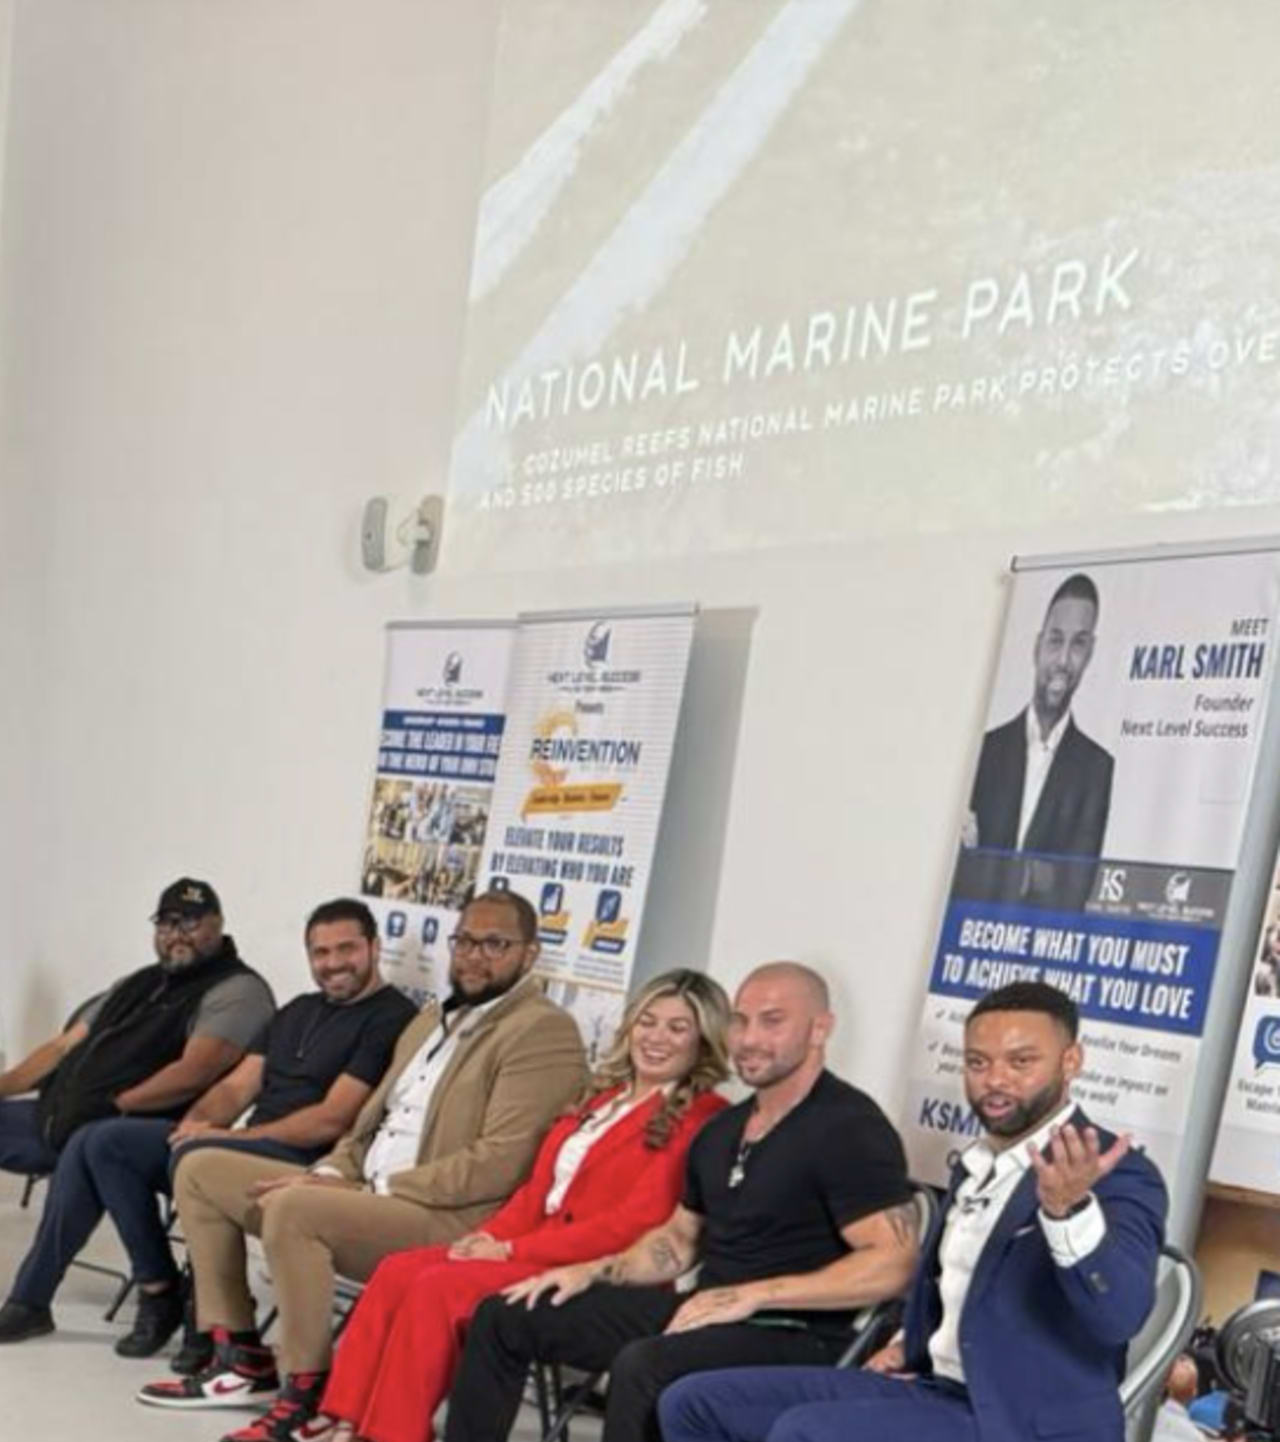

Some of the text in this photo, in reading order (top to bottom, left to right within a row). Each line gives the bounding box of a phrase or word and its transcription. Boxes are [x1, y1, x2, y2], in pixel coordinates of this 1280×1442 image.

[484, 247, 1140, 434] NATIONAL MARINE PARK
[522, 443, 614, 475] COZUMEL
[621, 426, 691, 457] REEFS
[697, 406, 814, 446] NATIONAL
[825, 388, 923, 428] MARINE
[934, 374, 1007, 413] PARK
[1018, 338, 1191, 394] PROTECTS
[560, 462, 647, 500] SPECIES
[653, 458, 685, 488] OF
[691, 451, 747, 483] FISH
[1230, 618, 1269, 636] MEET
[1129, 642, 1266, 680] KARL SMITH
[1194, 692, 1254, 712] Founder
[1121, 718, 1248, 738] Next Level Success
[610, 865, 636, 888] ARE
[959, 918, 1190, 977] BECOME WHAT YOU MUST
[942, 954, 965, 983] TO
[1099, 978, 1139, 1013] YOU
[1140, 981, 1195, 1021] LOVE
